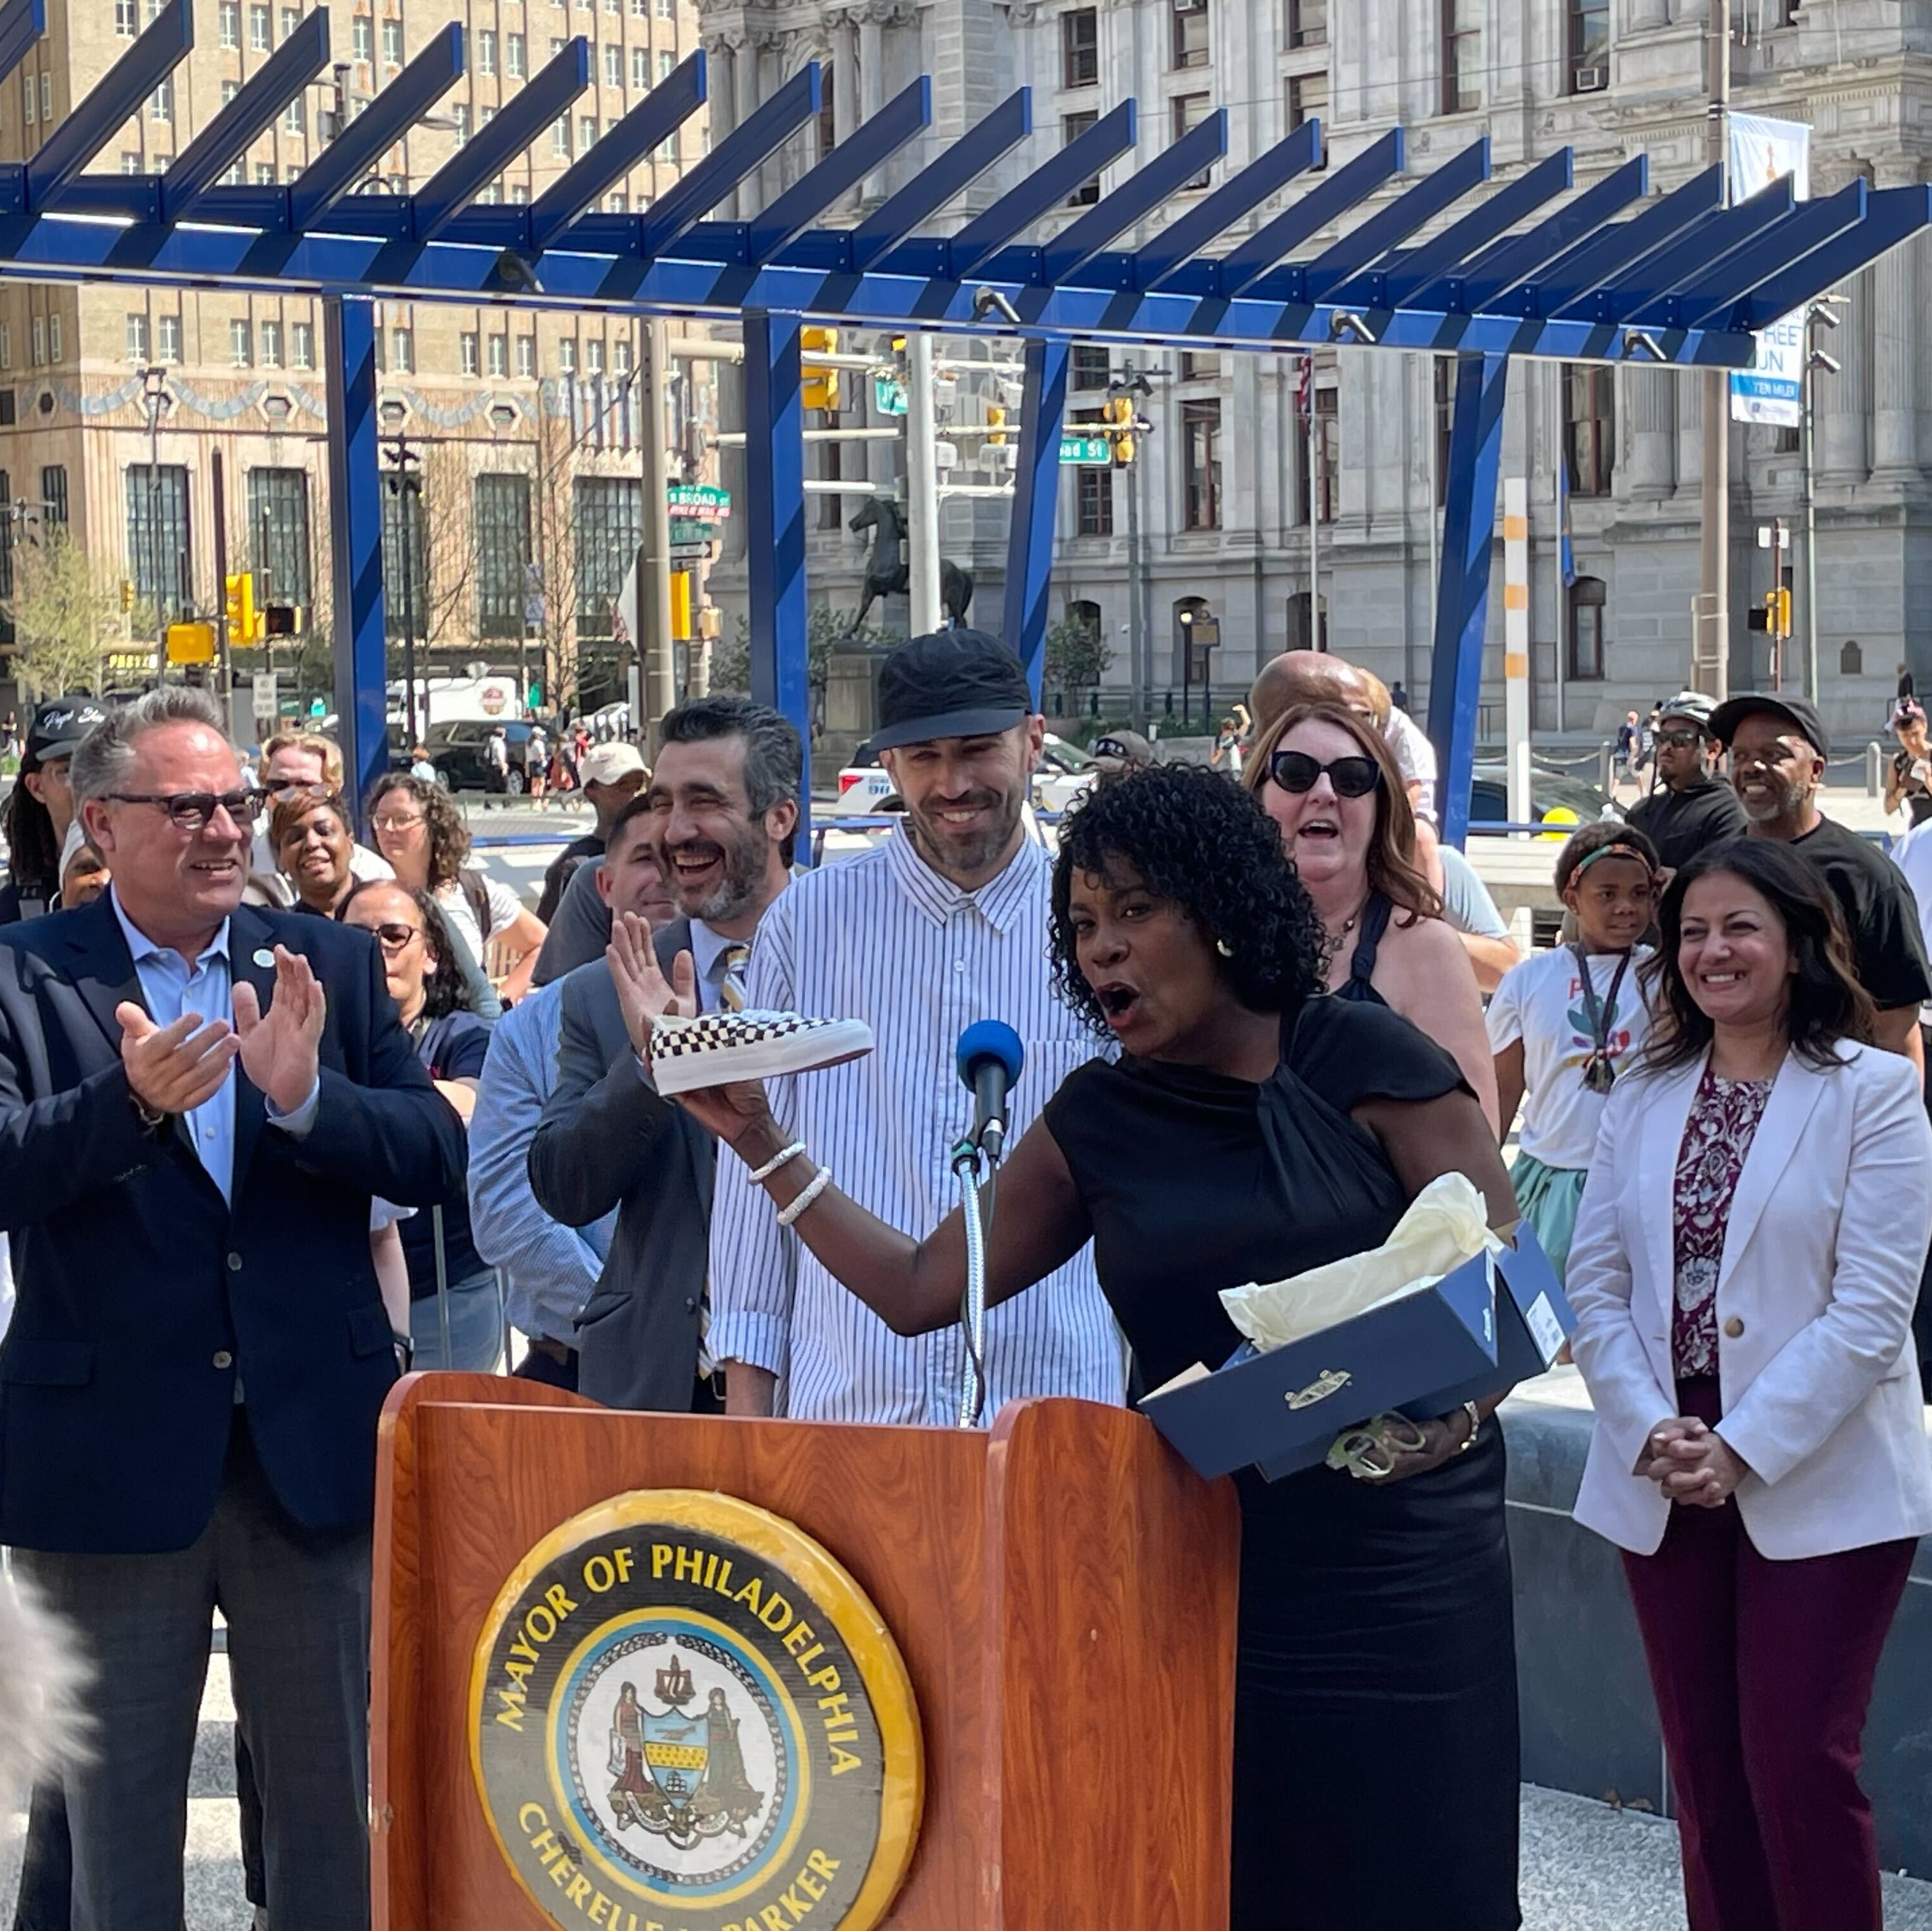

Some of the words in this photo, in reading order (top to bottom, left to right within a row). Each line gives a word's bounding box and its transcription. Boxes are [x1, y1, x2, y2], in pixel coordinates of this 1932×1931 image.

[1087, 441, 1103, 457] St
[679, 492, 717, 506] BROAD
[497, 1582, 578, 1732] MAYOR
[583, 1546, 635, 1594] OF
[651, 1543, 863, 1776] PHILADELPHIA
